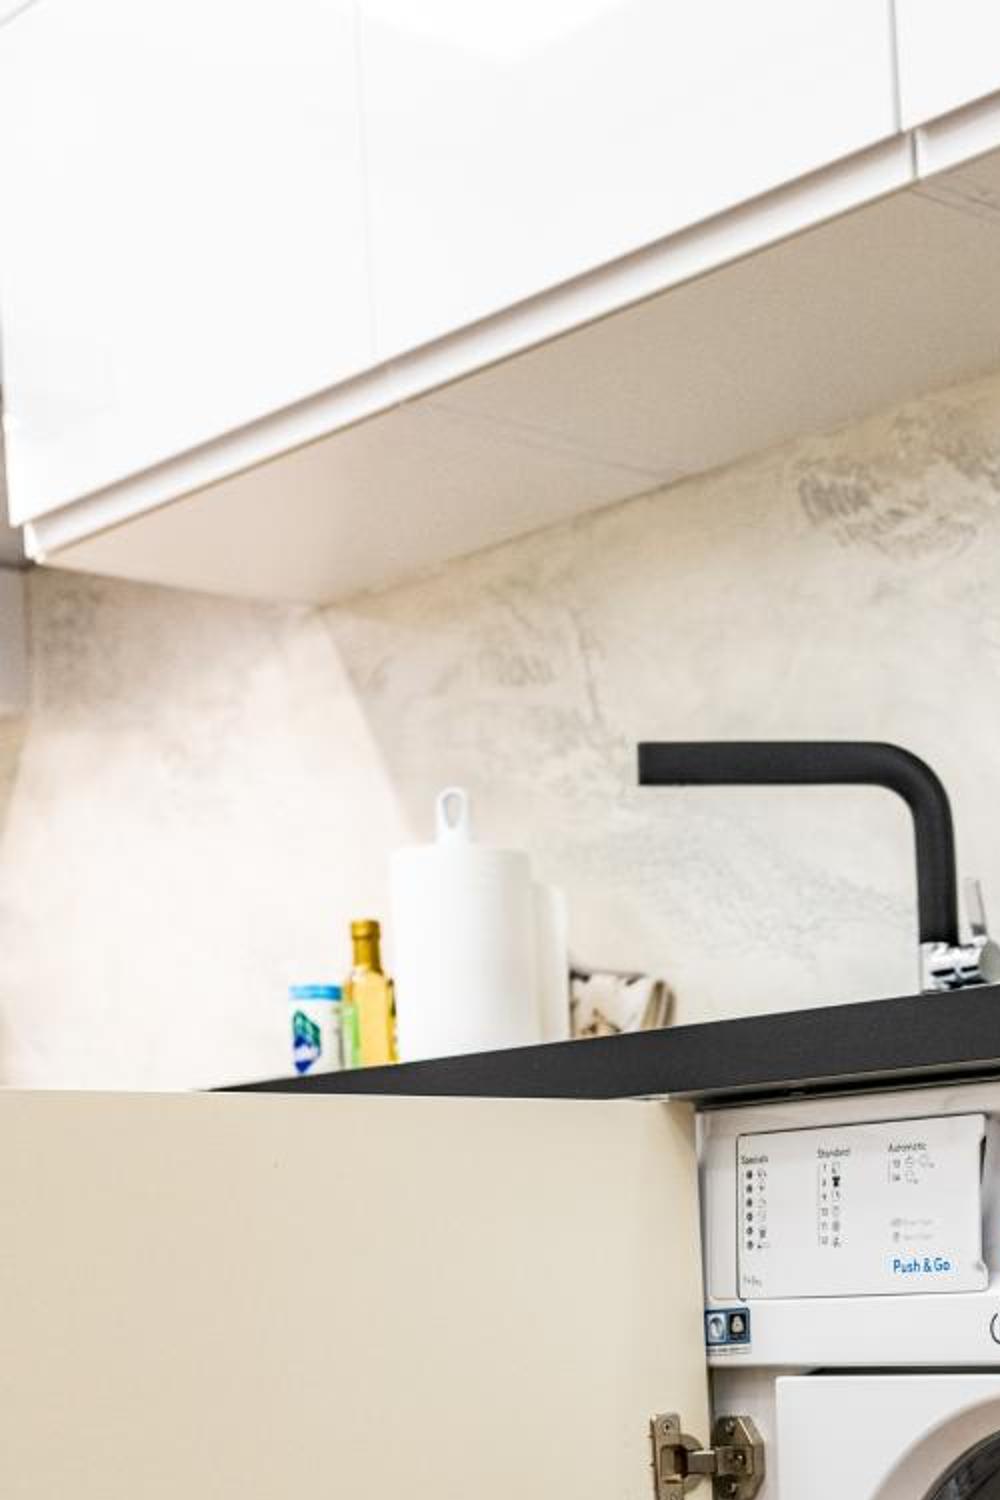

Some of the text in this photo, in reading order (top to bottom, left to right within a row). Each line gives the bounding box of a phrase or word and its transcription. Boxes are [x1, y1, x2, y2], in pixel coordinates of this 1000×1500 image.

[893, 1256, 951, 1274] Push & Go
